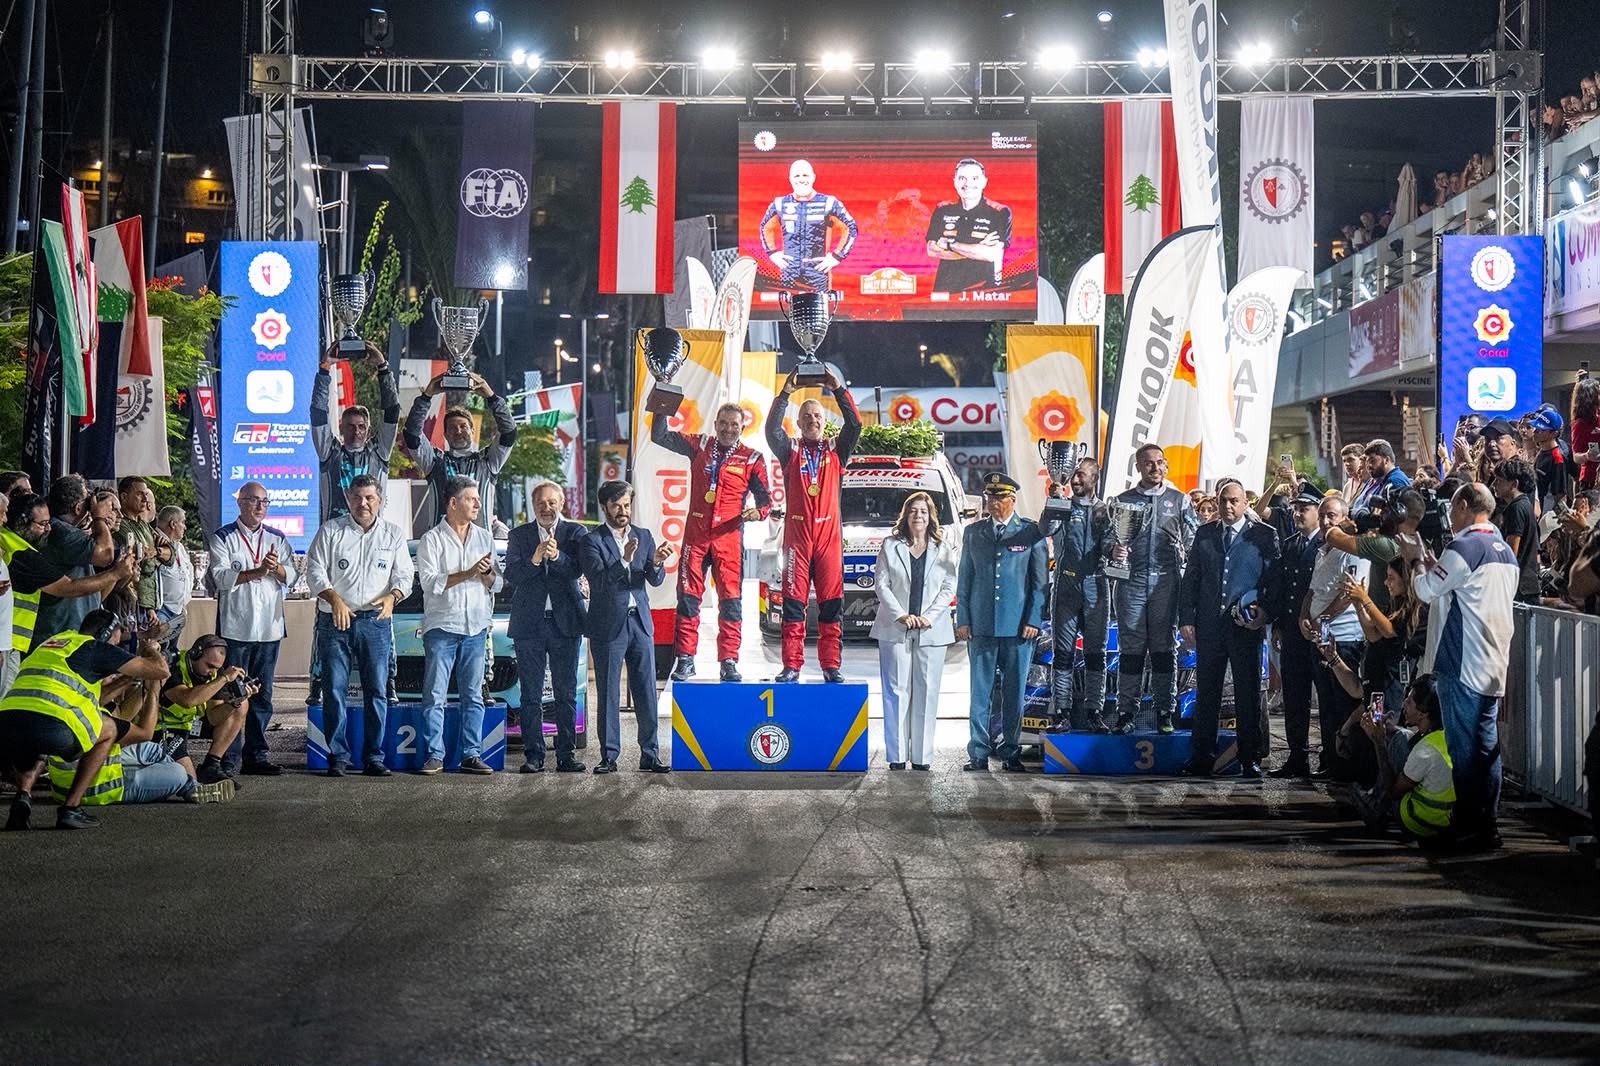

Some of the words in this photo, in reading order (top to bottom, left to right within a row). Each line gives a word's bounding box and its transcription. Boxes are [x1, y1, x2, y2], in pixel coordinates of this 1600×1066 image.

[958, 291, 969, 301] J.
[972, 291, 1011, 301] Matar
[256, 350, 286, 362] Coral
[1478, 347, 1508, 357] Coral
[1398, 377, 1432, 385] PISCINE
[931, 397, 1000, 425] Cor
[248, 446, 295, 454] Lebanon
[246, 465, 312, 474] COMMERCIAL
[770, 458, 786, 503] oral
[758, 688, 774, 717] 1
[396, 725, 417, 754] 2
[1135, 740, 1154, 769] 3
